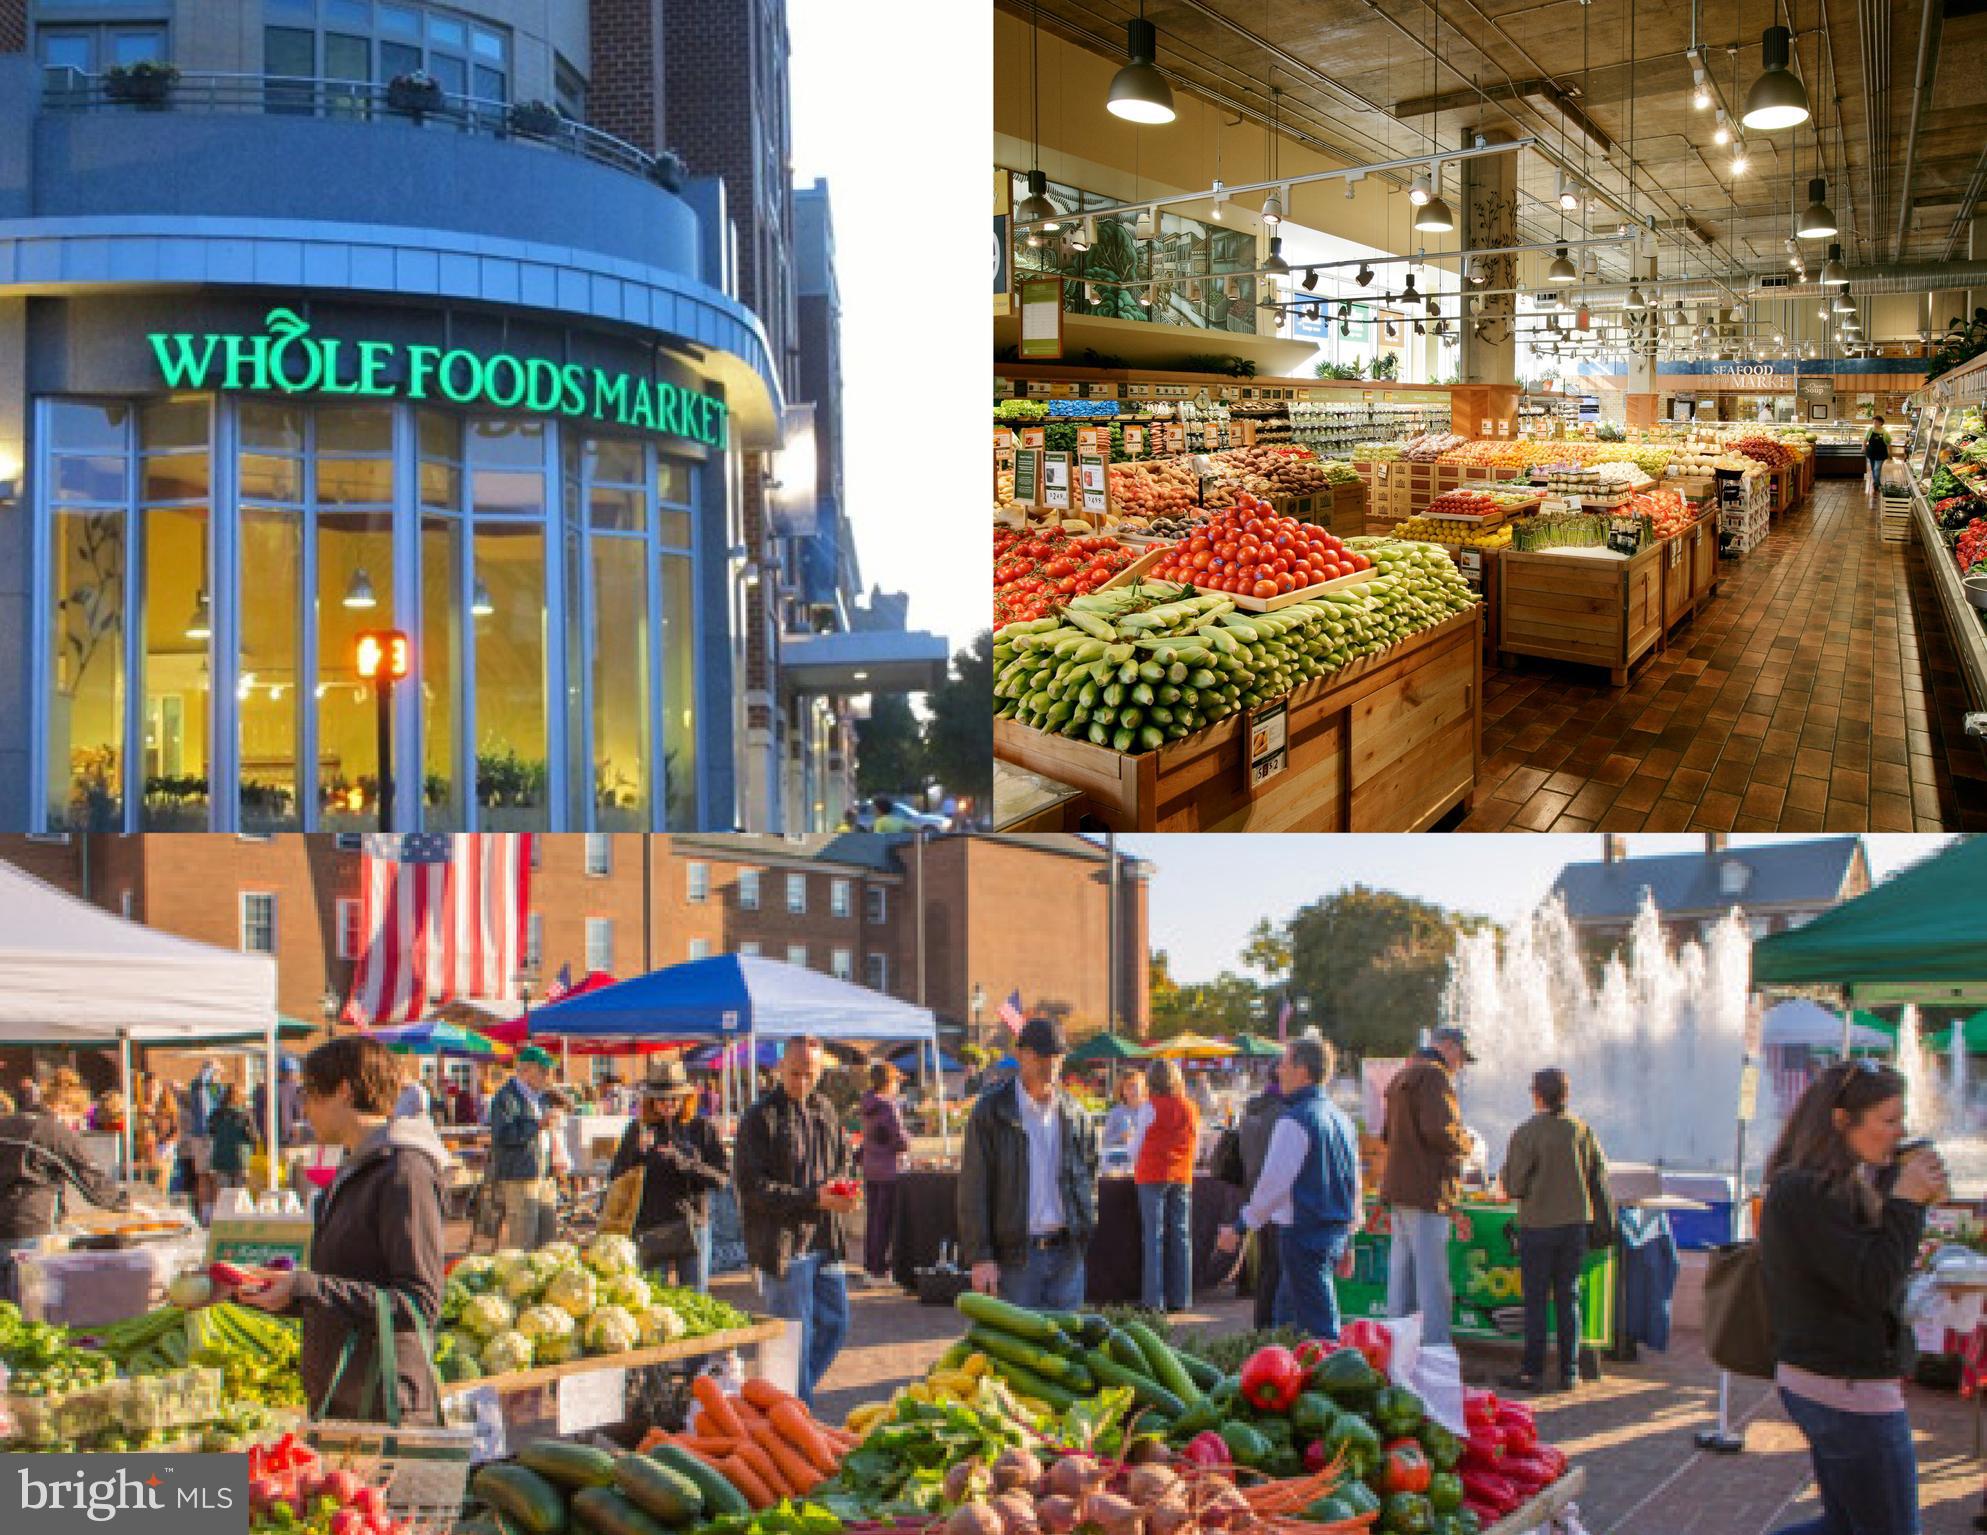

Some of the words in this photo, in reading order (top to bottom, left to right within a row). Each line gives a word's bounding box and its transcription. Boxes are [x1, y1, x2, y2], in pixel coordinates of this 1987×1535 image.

[1712, 365, 1774, 376] SEAFOOD
[147, 308, 395, 396] WHOLE
[405, 345, 586, 416] FOODS
[591, 367, 728, 449] MARKET
[1732, 375, 1794, 388] MARKE
[1804, 386, 1824, 395] Soup
